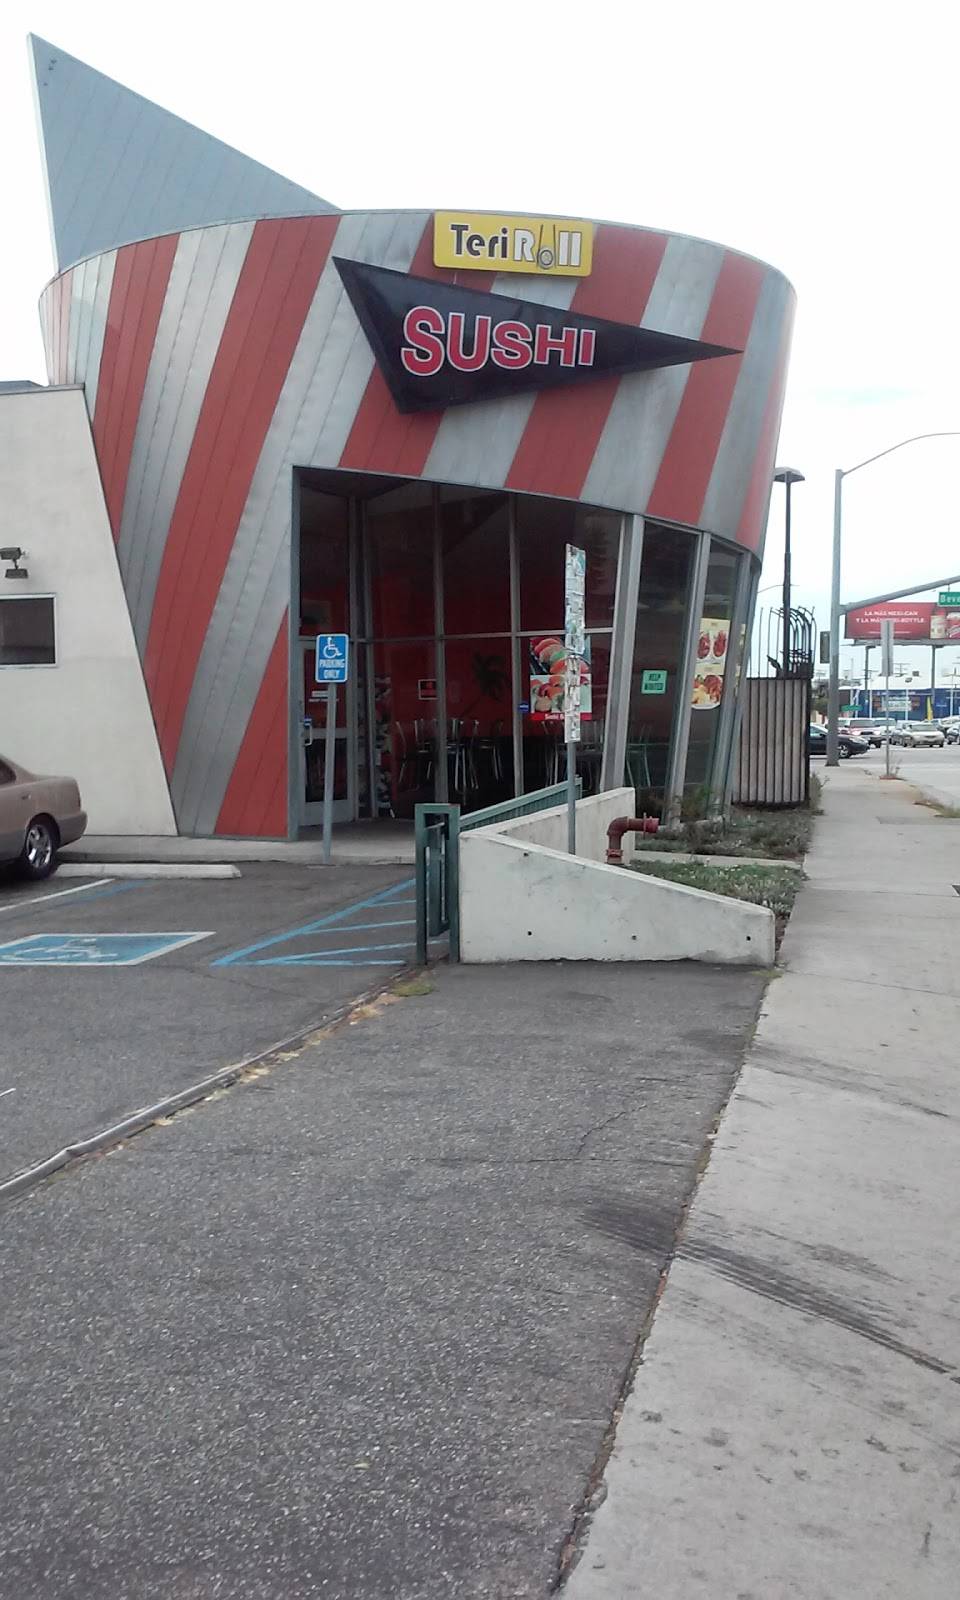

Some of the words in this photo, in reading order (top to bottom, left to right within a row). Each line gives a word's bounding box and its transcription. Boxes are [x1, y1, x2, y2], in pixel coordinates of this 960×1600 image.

[401, 305, 596, 376] SUSHI
[320, 659, 345, 668] PARKING
[324, 670, 340, 679] ONLY
